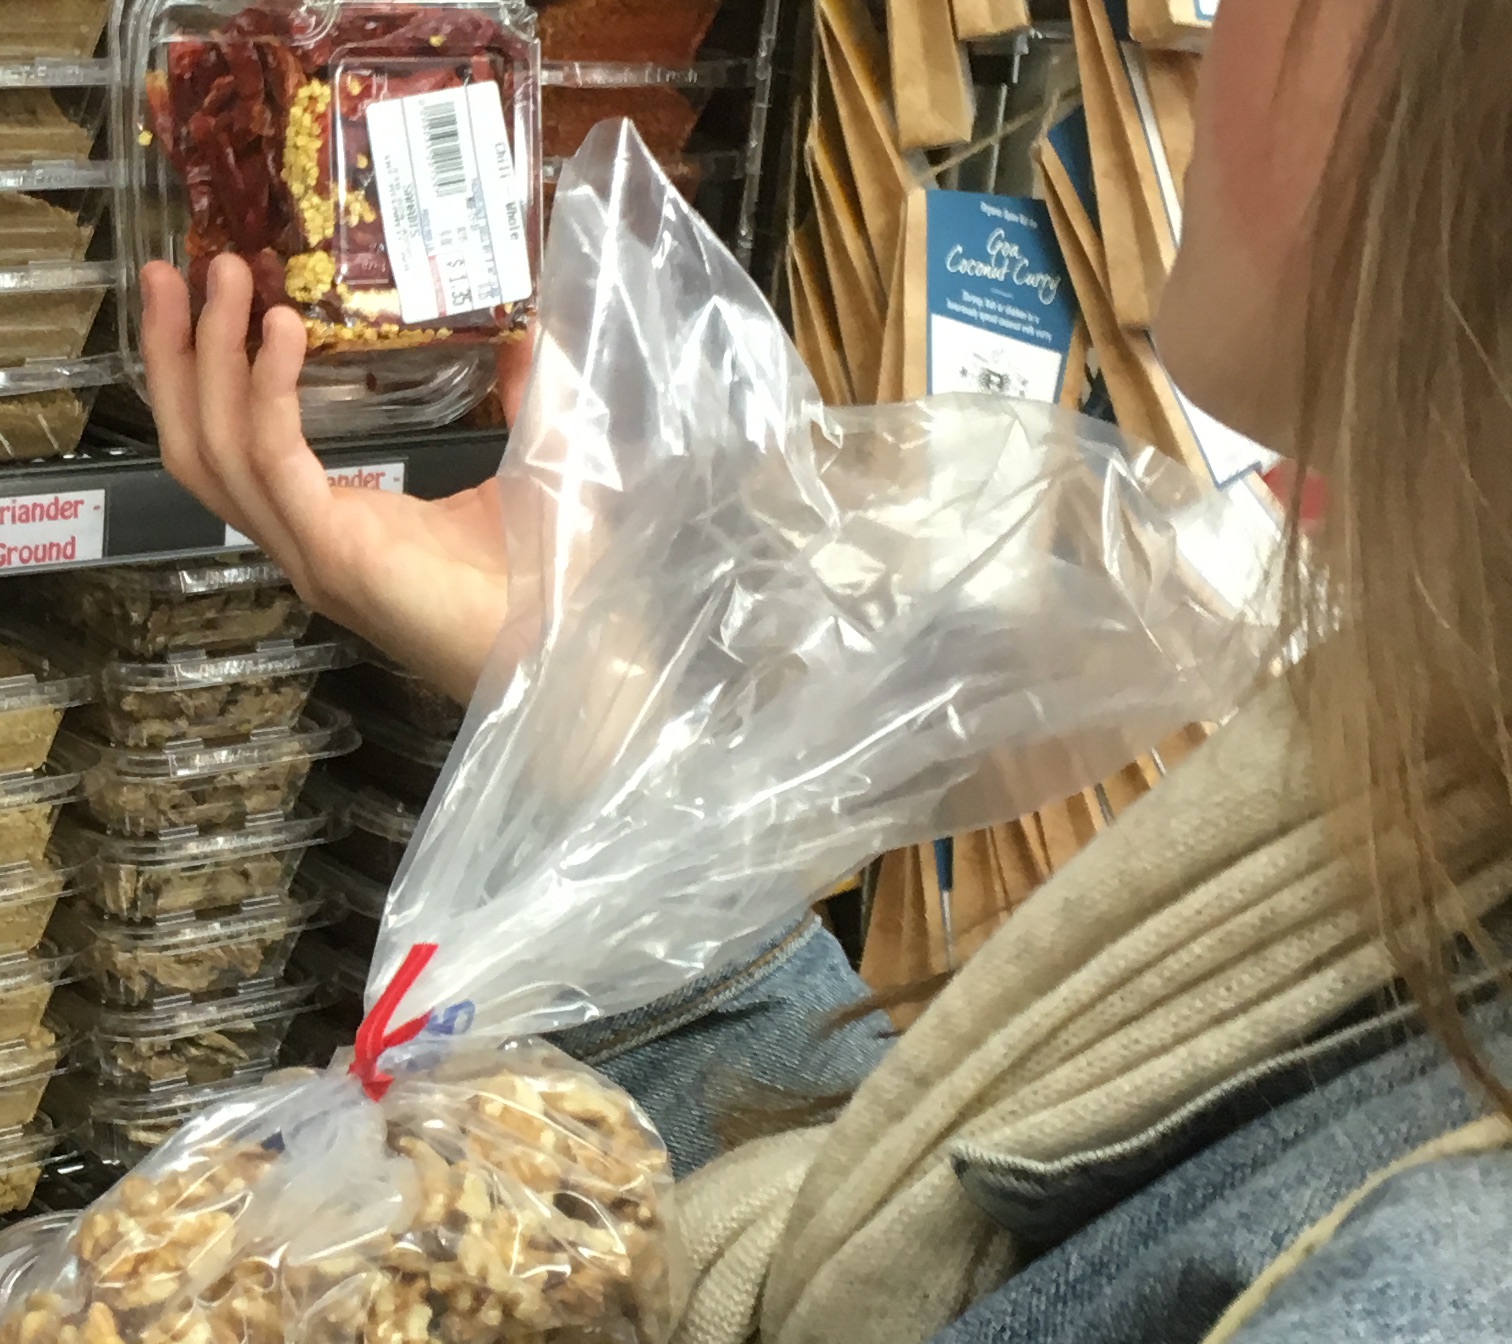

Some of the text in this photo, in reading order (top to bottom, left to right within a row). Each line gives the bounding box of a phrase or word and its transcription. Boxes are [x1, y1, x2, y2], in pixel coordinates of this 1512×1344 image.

[506, 200, 520, 240] Whole
[987, 227, 1022, 260] Goa
[946, 244, 1061, 305] Coconut Curry
